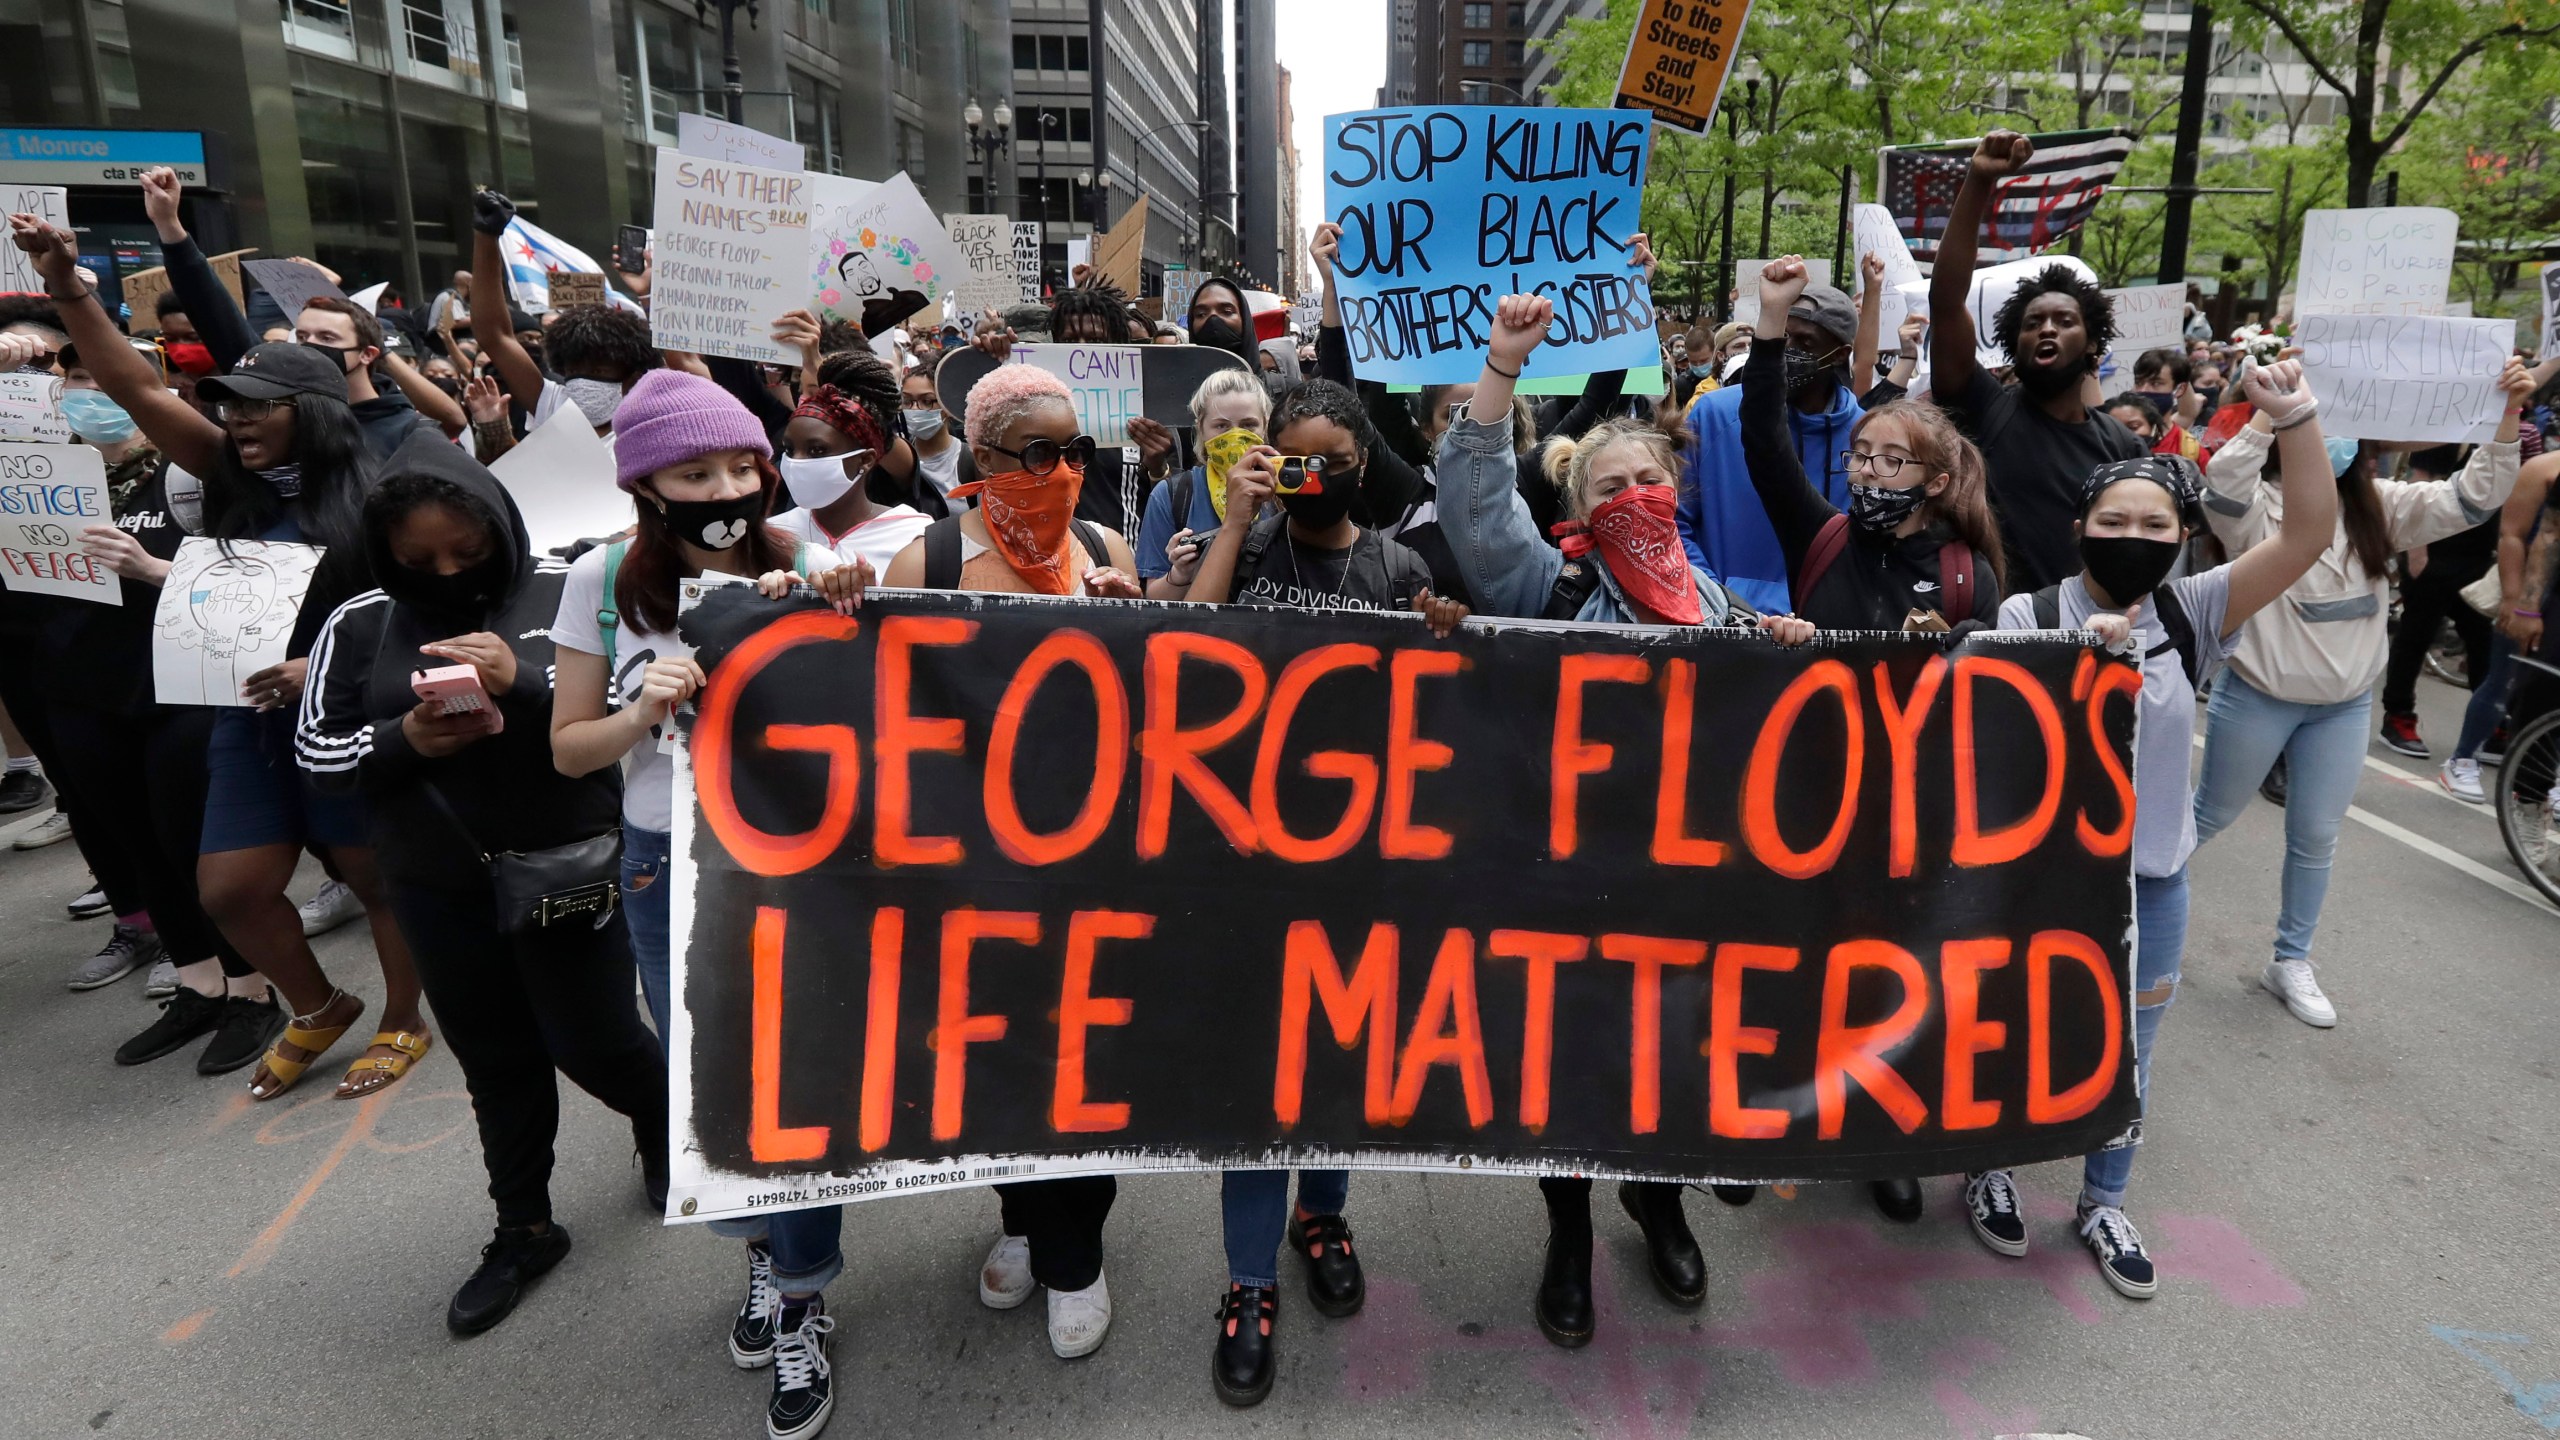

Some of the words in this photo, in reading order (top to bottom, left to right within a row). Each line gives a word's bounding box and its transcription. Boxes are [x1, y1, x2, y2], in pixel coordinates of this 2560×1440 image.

[1661, 0, 1683, 23] to
[1688, 5, 1723, 35] the
[1647, 19, 1721, 62] Streets
[1656, 54, 1697, 80] and
[1642, 71, 1696, 107] Stay!
[18, 135, 109, 157] Monroe
[702, 121, 777, 160] Justice
[1330, 112, 1468, 188] STOP
[1484, 113, 1644, 187] KILLING
[103, 167, 125, 180] cta
[676, 162, 730, 198] SAY
[734, 171, 803, 205] THEIR
[682, 199, 768, 235] NAMES
[767, 209, 808, 226] #BLM
[845, 202, 890, 229] George
[1912, 173, 2083, 255] FCK
[952, 225, 997, 243] BLACK
[1013, 223, 1036, 236] ARE
[1336, 198, 1434, 279] OUR
[1478, 189, 1627, 268] BLACK
[665, 230, 719, 259] GEORGE
[720, 242, 761, 265] FLOYD
[960, 241, 994, 257] IVES
[2363, 242, 2449, 272] MURDE
[660, 259, 722, 284] BREONNA
[727, 271, 773, 291] TAYLOR
[969, 253, 1017, 273] ATTER
[1021, 286, 1037, 297] THE
[1301, 296, 1323, 309] BLAC
[655, 306, 691, 333] TONY
[1302, 310, 1323, 323] LIVE
[1339, 283, 1493, 363] BROTHERS
[1537, 273, 1652, 348] SISTERS
[656, 332, 691, 351] BLACK
[699, 336, 731, 356] LIVES
[735, 342, 779, 361] MATTER
[2301, 316, 2410, 375] BLACK
[2419, 319, 2507, 378] LIVES
[1068, 348, 1142, 381] CAN'T
[2322, 377, 2492, 428] MATTER!!
[1, 454, 53, 480] NO
[0, 483, 100, 517] STICE
[19, 523, 70, 547] NO
[2, 547, 107, 586] PEACE
[1249, 576, 1284, 600] JOY
[1287, 585, 1380, 612] DIVISION
[1918, 580, 1935, 590] NIKE
[518, 627, 551, 640] adida
[693, 608, 1465, 878] GEORGE
[1550, 649, 2143, 879] FLOYD'S
[749, 905, 1157, 1163] LIFE
[1273, 918, 2122, 1141] MATTERED
[817, 1179, 888, 1201] 400565534
[895, 1170, 966, 1189] 03/04/2019
[747, 1189, 809, 1208] 74786415
